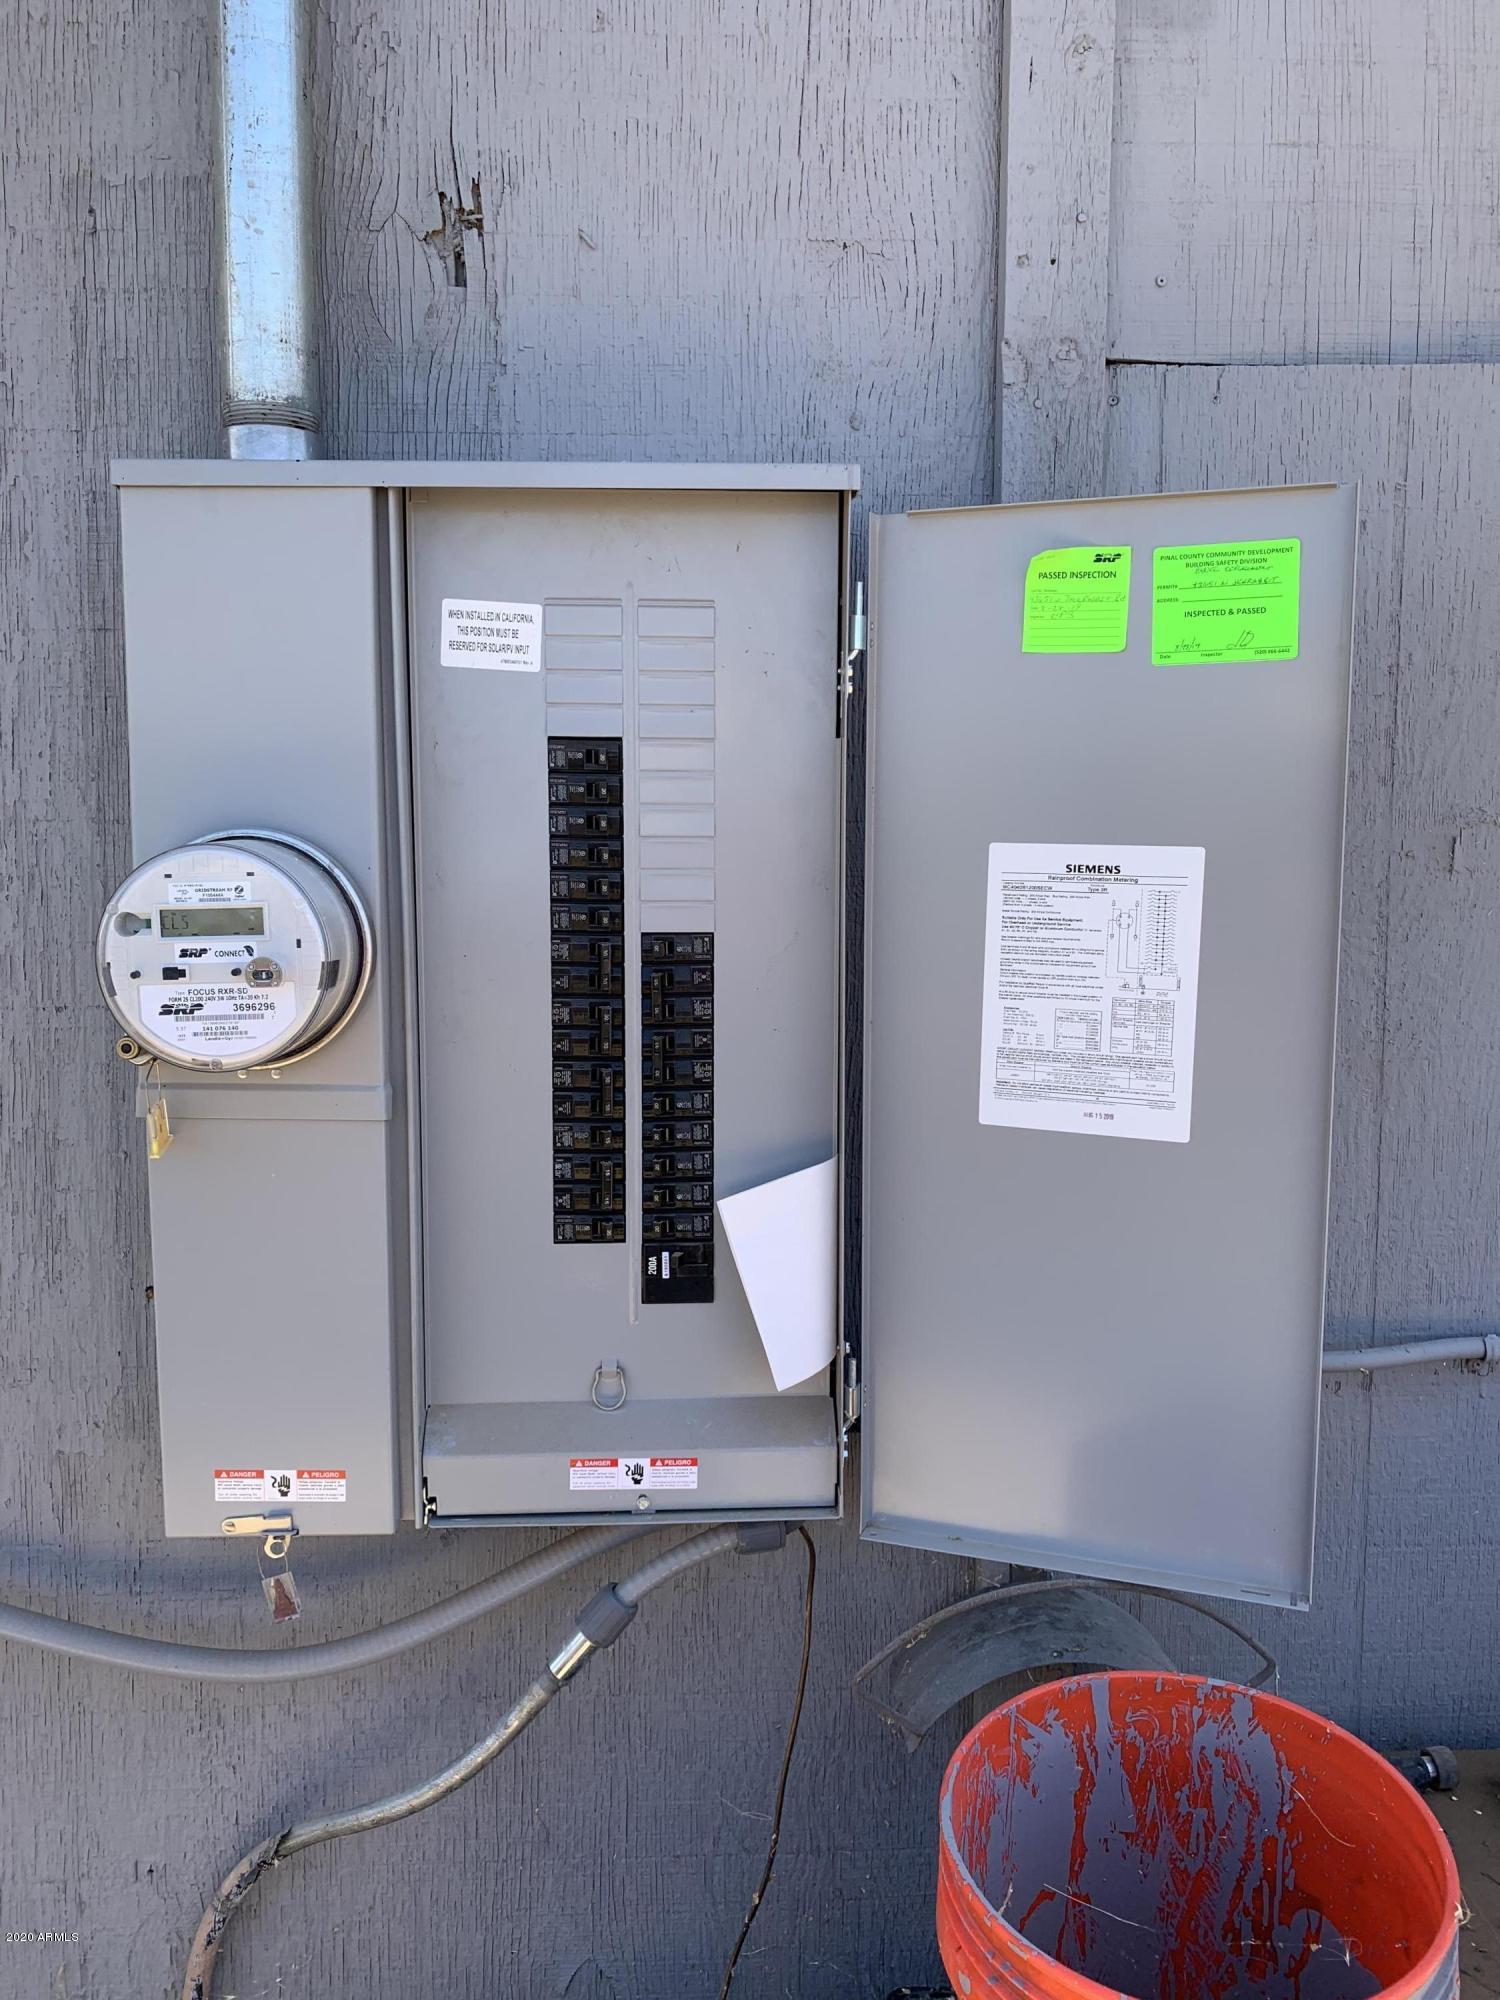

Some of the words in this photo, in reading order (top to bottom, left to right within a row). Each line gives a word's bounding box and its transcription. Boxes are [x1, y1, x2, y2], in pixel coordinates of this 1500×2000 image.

[1093, 553, 1122, 563] SRP
[1179, 552, 1205, 560] COUNTY
[1206, 550, 1246, 559] COMMUNITY
[1247, 546, 1294, 556] DEVELOPMENT
[1185, 560, 1215, 568] BUILDING
[1240, 557, 1268, 565] DIVISION
[1038, 571, 1068, 579] PASSED
[1069, 570, 1117, 579] INSPECTION
[448, 609, 465, 619] WHEN
[465, 610, 494, 621] INSTALLED
[495, 612, 501, 622] IN
[1184, 608, 1227, 618] INSPECTED
[1228, 608, 1234, 616] &
[1236, 606, 1267, 615] PASSED
[457, 625, 469, 636] THIS
[470, 626, 495, 637] POSITION
[495, 628, 511, 638] MUST
[511, 629, 519, 639] BE
[448, 640, 476, 652] RESERVED
[476, 642, 488, 652] FOR
[488, 643, 514, 654] SOLAR/PV
[514, 644, 530, 655] INPUT
[1065, 863, 1121, 875] SIEMENS
[178, 948, 208, 958] SRP
[187, 988, 215, 996] FOCUS
[158, 1003, 205, 1016] SRP
[232, 1002, 276, 1012] 3696296
[647, 1255, 658, 1275] 200A
